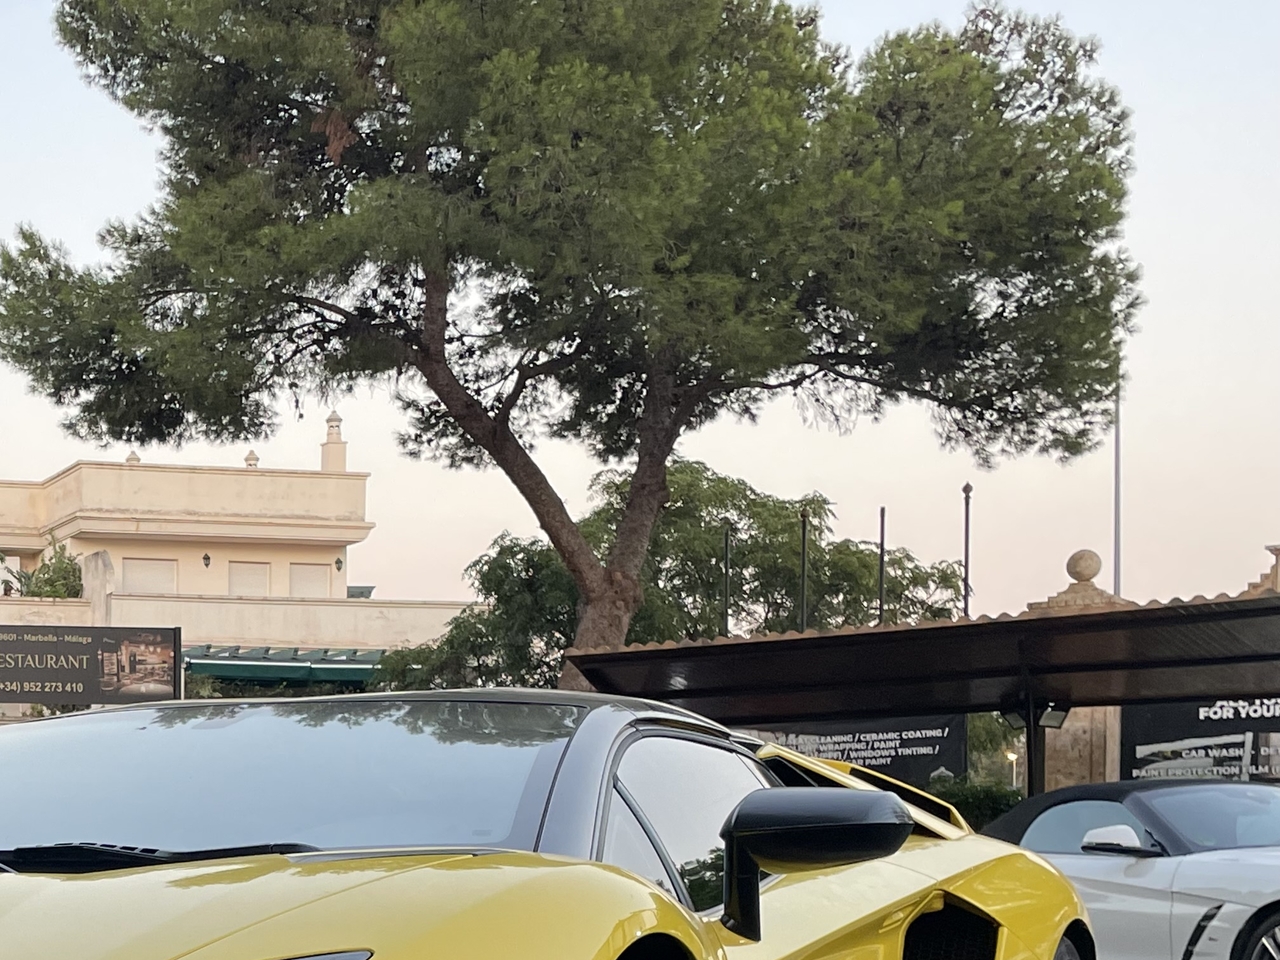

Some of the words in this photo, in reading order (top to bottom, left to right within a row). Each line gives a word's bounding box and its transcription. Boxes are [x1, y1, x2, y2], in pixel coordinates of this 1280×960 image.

[24, 633, 57, 642] Marbella
[64, 634, 92, 644] Málaga
[23, 682, 42, 692] 952
[44, 682, 62, 693] 273
[65, 683, 84, 693] 410
[1199, 707, 1235, 720] FOR
[860, 732, 901, 741] CERAMIC
[902, 729, 943, 739] COATING
[874, 740, 901, 749] PAINT
[849, 749, 896, 758] WINDOWS
[897, 746, 934, 756] TINTING
[1182, 749, 1206, 758] CAR
[1207, 747, 1243, 758] WASH
[865, 757, 892, 766] PAINT
[1168, 765, 1240, 777] PROTECTION
